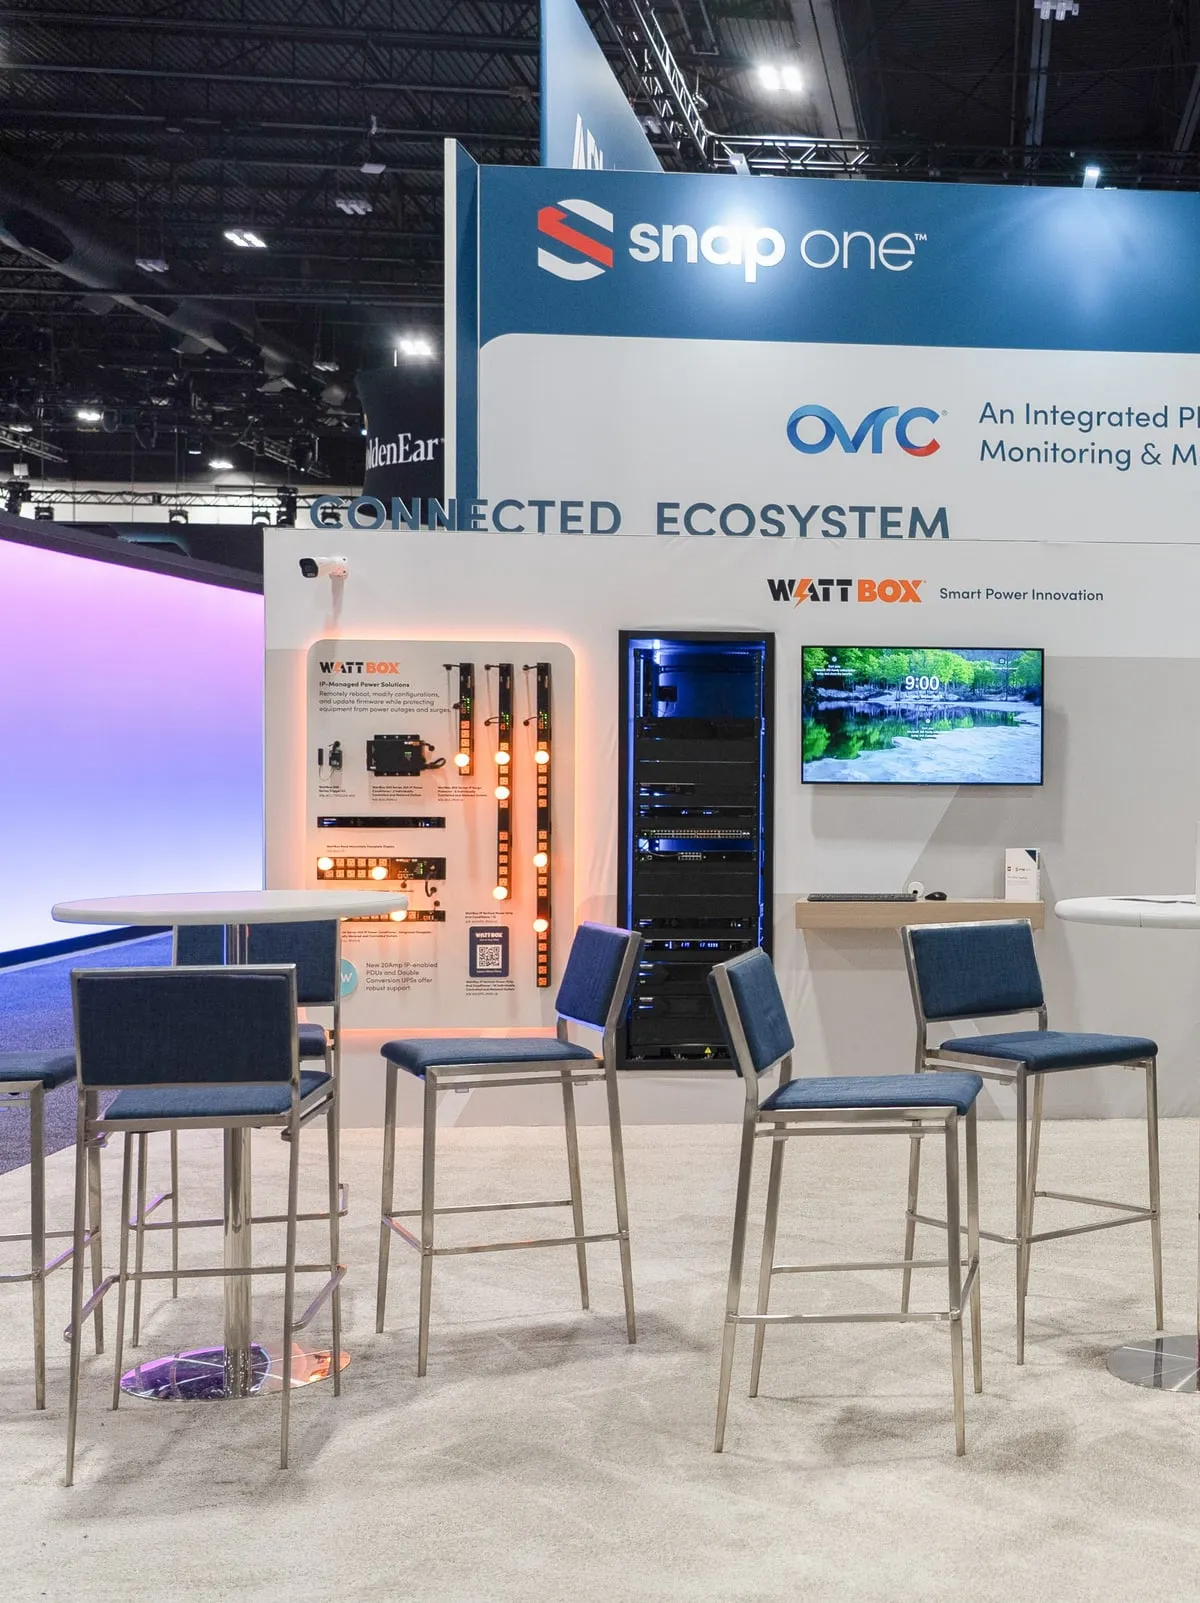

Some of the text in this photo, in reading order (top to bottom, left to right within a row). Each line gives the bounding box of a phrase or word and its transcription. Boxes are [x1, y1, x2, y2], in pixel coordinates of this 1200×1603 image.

[628, 221, 786, 283] snap
[978, 401, 1016, 426] An
[1024, 403, 1169, 432] Integrated
[978, 439, 1131, 472] Monitoring
[1140, 444, 1162, 467] &
[310, 495, 950, 539] CONNECTED ECOSYSTEM
[940, 587, 983, 601] Smart
[985, 588, 1029, 601] Power
[1032, 588, 1105, 601] Innovation
[319, 681, 359, 689] IP-Managed
[905, 675, 940, 690] 9:00
[319, 690, 347, 698] Remotely
[372, 691, 393, 699] modify
[403, 699, 435, 707] protecting
[381, 962, 404, 970] 20Amp
